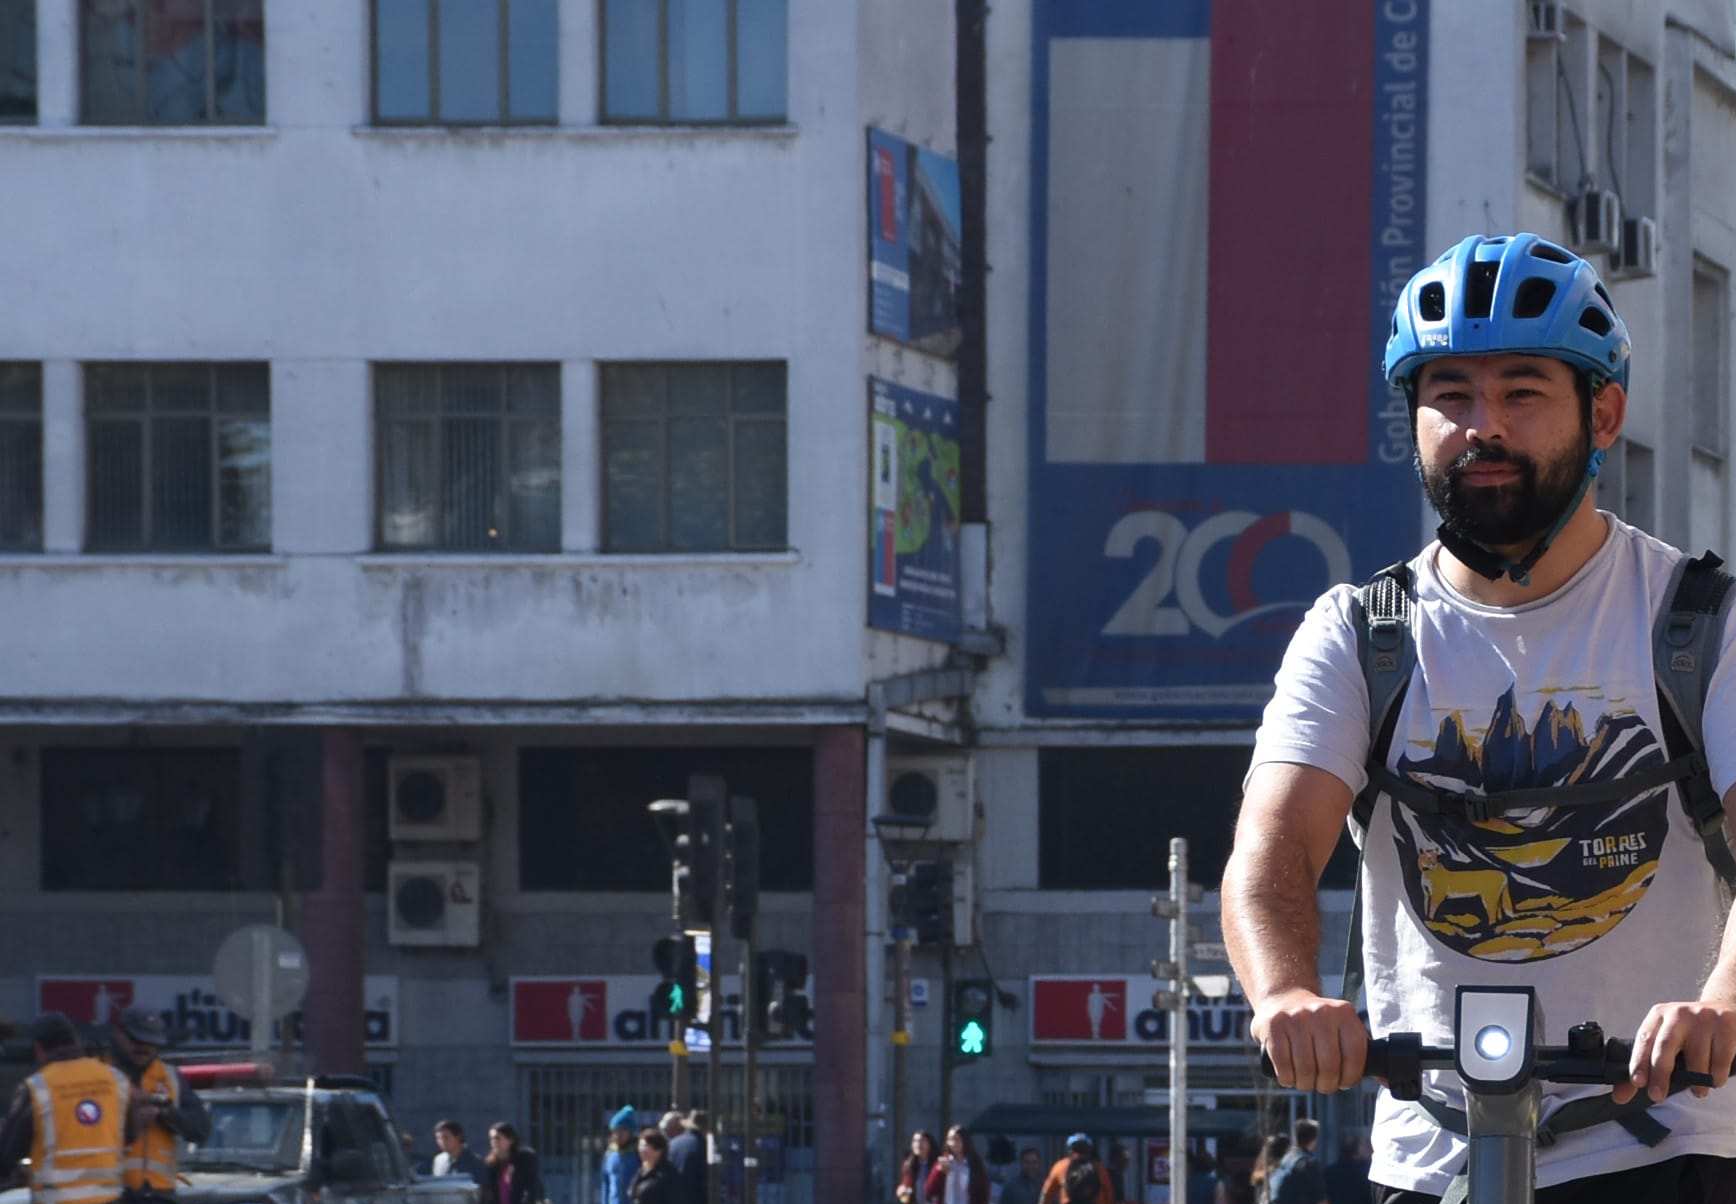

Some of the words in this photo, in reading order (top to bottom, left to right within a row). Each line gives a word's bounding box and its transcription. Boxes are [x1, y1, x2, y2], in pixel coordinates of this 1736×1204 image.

[1385, 30, 1417, 72] de
[1381, 79, 1416, 247] Provincial
[1579, 832, 1646, 857] TORRES
[1600, 853, 1639, 868] PAINE
